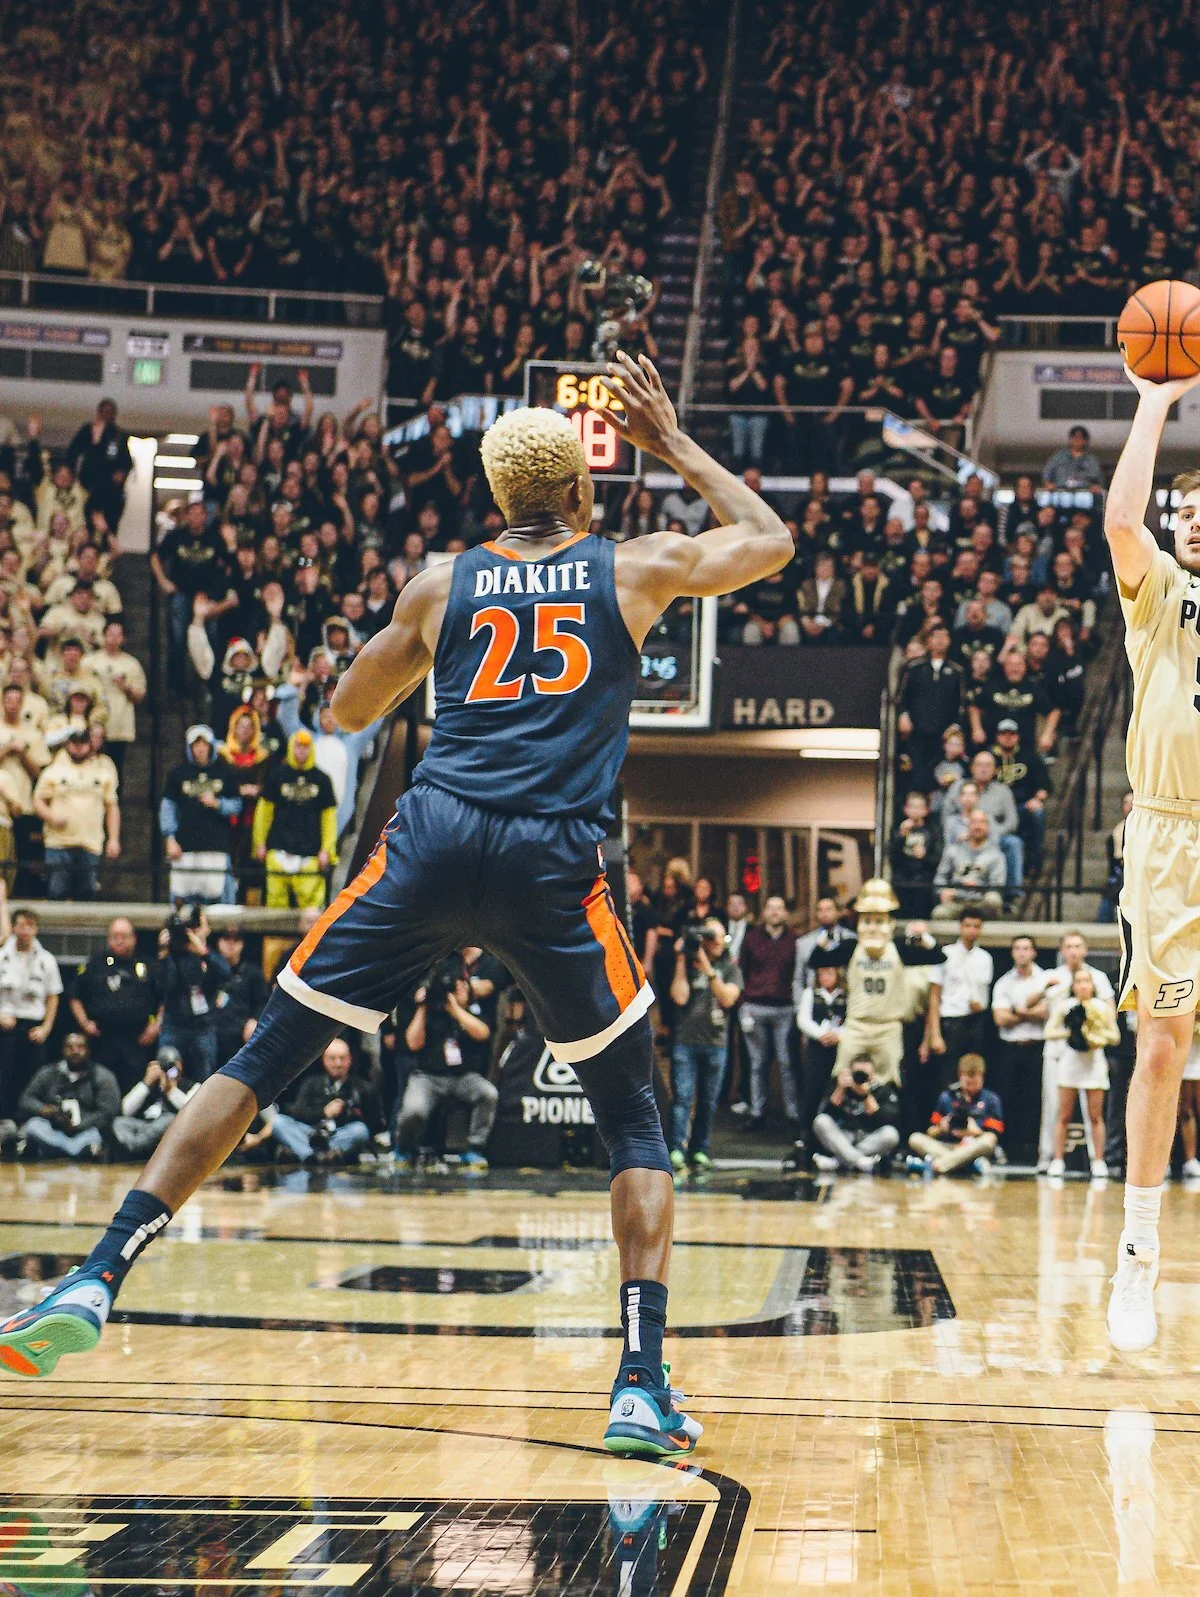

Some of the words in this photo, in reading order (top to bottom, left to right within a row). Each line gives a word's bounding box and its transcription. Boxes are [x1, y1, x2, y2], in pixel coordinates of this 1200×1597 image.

[473, 560, 591, 598] DIAKITE
[464, 602, 592, 704] 25
[732, 698, 835, 725] HARD
